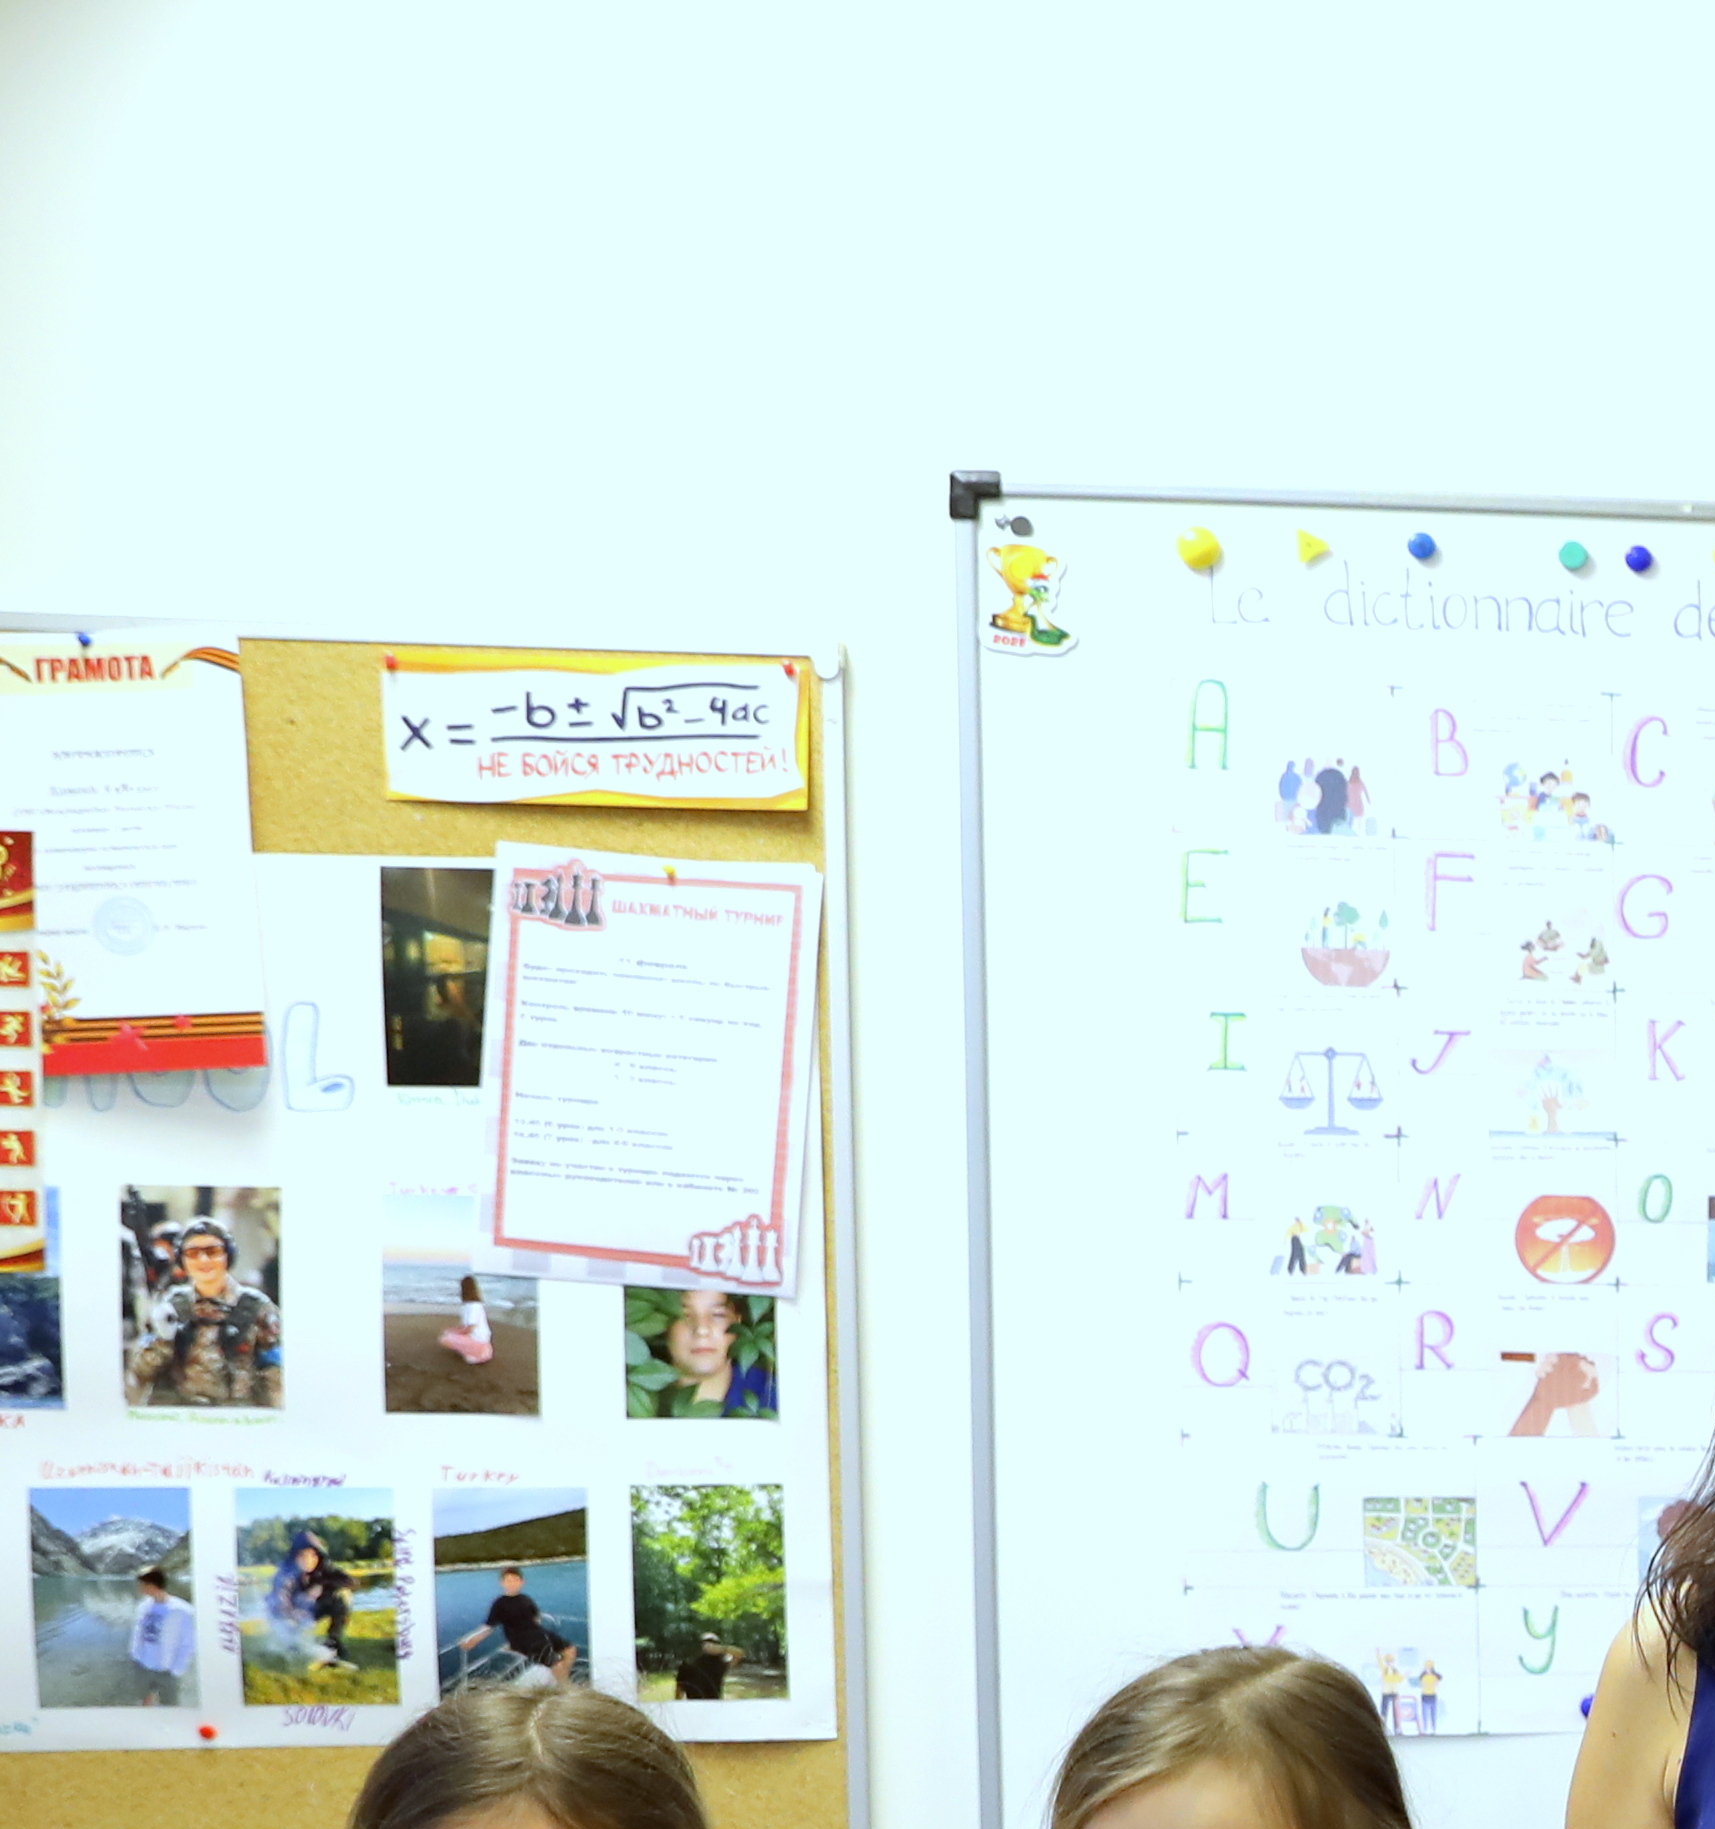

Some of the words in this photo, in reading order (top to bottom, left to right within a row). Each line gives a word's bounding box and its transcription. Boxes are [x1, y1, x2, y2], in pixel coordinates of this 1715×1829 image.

[1324, 557, 1634, 638] dictionnaire
[35, 655, 154, 683] ГРАМОТА
[479, 752, 508, 777] НЕ
[522, 751, 598, 776] БОЙСЯ
[612, 750, 786, 779] ТРУДНОСТЕЙ!
